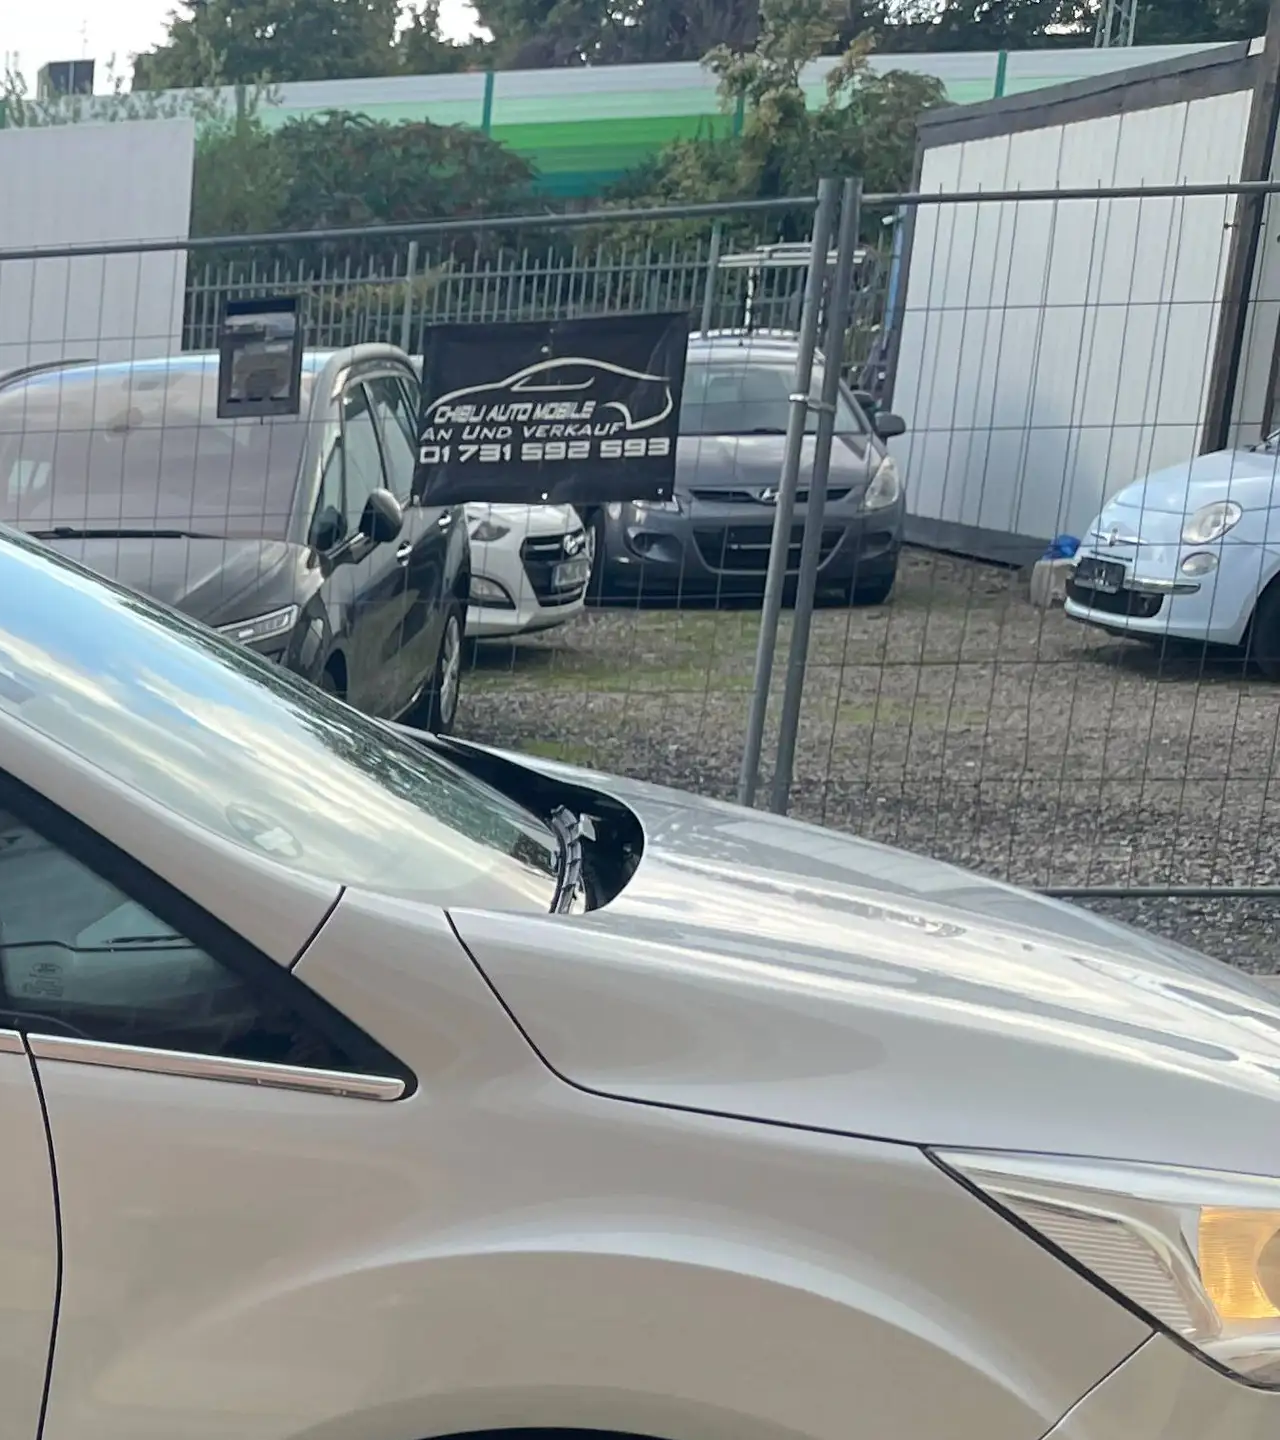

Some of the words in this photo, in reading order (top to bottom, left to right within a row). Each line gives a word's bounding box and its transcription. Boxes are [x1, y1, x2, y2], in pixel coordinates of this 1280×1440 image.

[485, 402, 533, 421] AUTO
[521, 440, 591, 460] 592
[600, 437, 670, 458] 593
